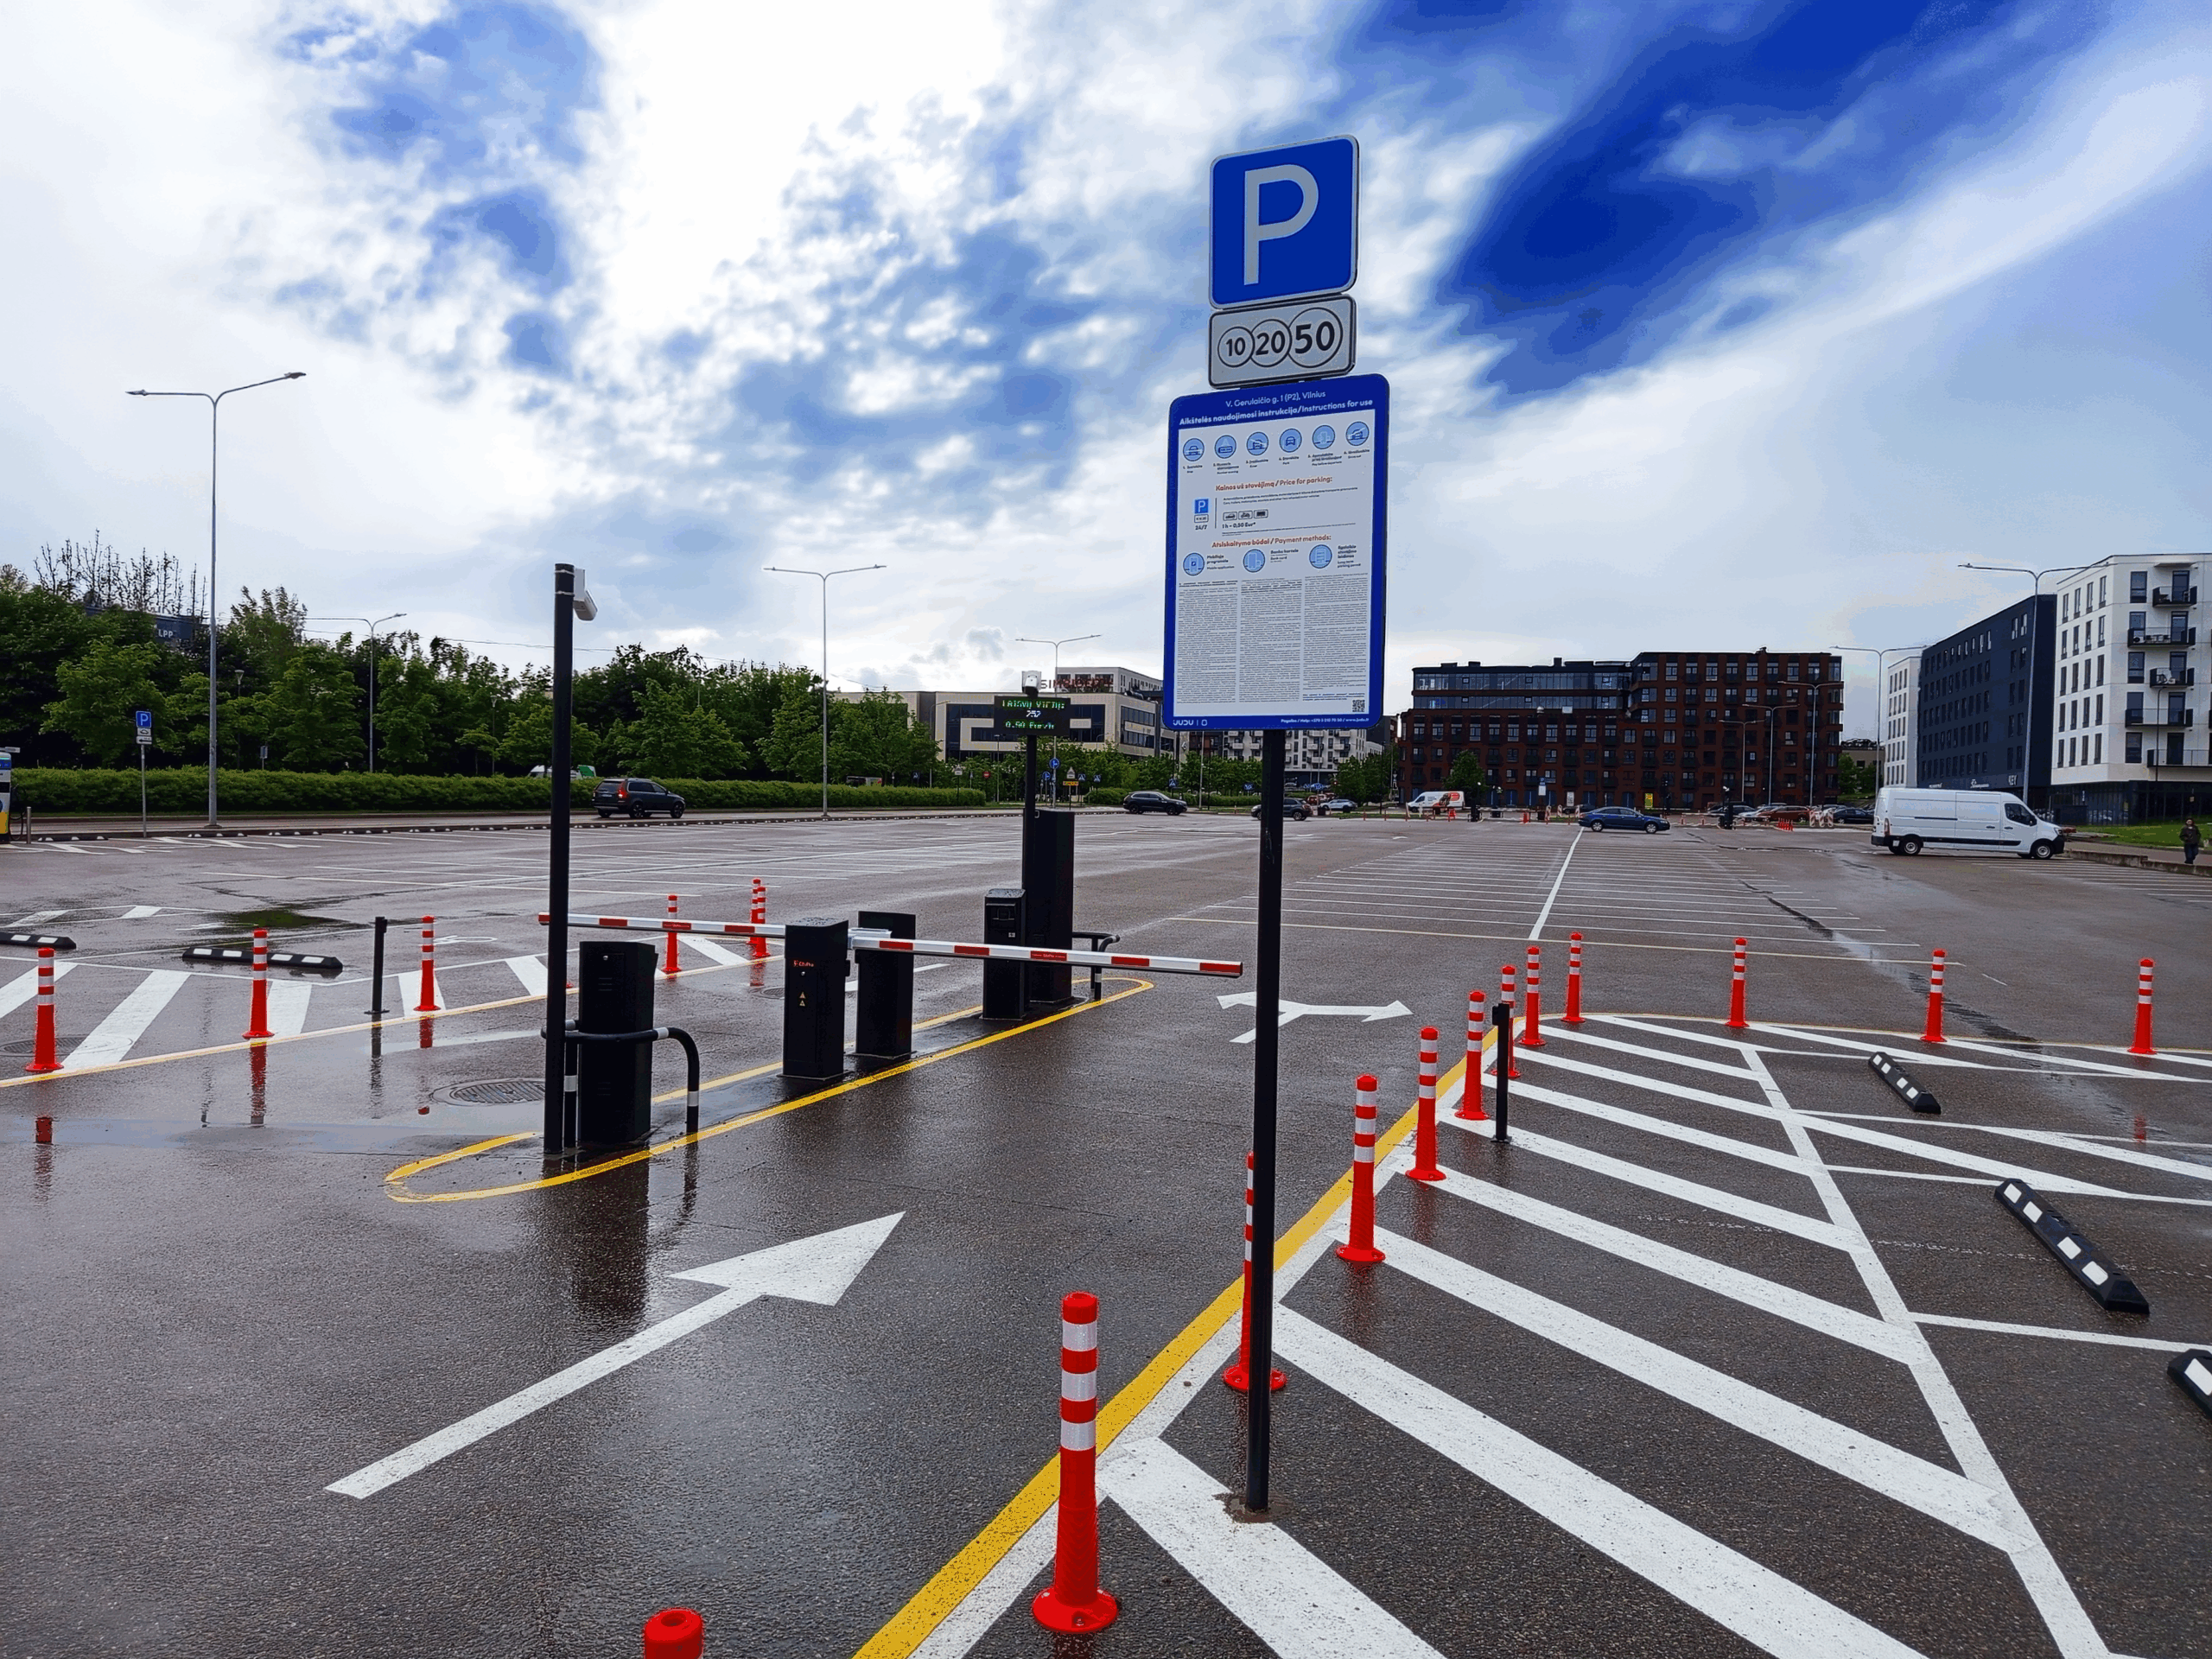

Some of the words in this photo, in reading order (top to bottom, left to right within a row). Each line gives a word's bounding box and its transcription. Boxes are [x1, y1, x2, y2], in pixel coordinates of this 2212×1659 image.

[1244, 164, 1319, 285] P
[1225, 337, 1246, 357] 10
[1255, 330, 1286, 355] 20
[1294, 321, 1335, 354] 50
[1302, 391, 1325, 399] Vilnius
[1179, 416, 1211, 425] Aikštelės
[1213, 410, 1256, 421] naudojimosi
[1198, 500, 1206, 513] P
[140, 714, 149, 726] P
